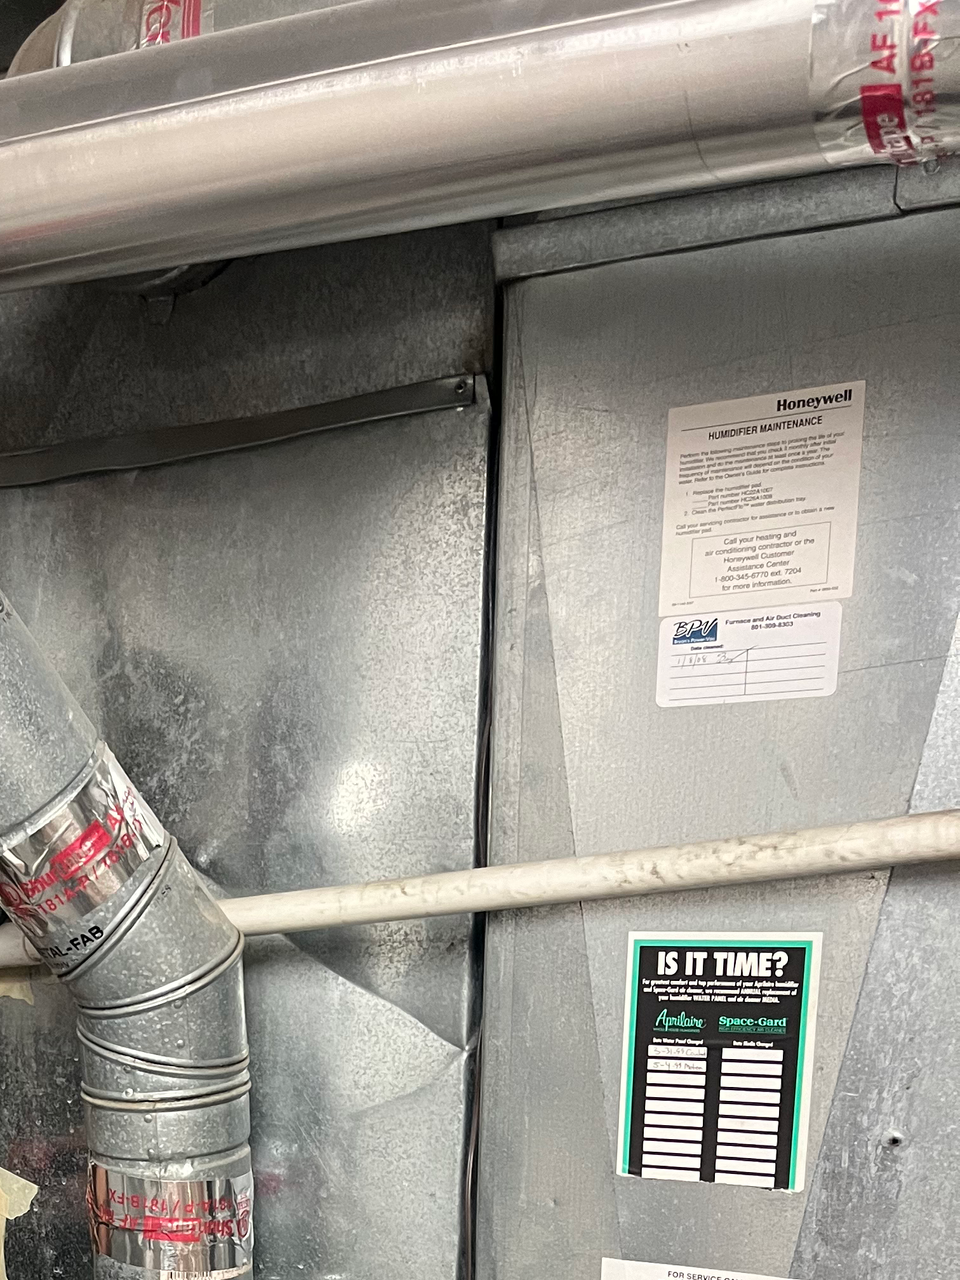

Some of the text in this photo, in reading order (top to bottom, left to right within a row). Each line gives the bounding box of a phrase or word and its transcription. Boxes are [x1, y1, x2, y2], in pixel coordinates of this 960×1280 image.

[870, 34, 898, 74] AF
[776, 388, 852, 413] Honeywell
[708, 415, 822, 440] HUMIDIFIER MAINTENANCE
[723, 537, 736, 545] Call
[738, 536, 753, 544] your
[756, 532, 781, 542] heating
[715, 544, 756, 557] conditioning
[758, 540, 792, 550] contractor
[723, 549, 794, 564] Honeywell Customer
[727, 559, 789, 572] Assistance Center
[752, 577, 791, 587] information.
[725, 617, 750, 625] Furnace
[792, 611, 820, 620] Cleaning
[673, 618, 717, 637] BPV
[657, 950, 788, 977] IS IT TIME?
[655, 1008, 707, 1032] Aprilaire
[718, 1015, 786, 1028] Space-Gard
[667, 1270, 684, 1279] FOR
